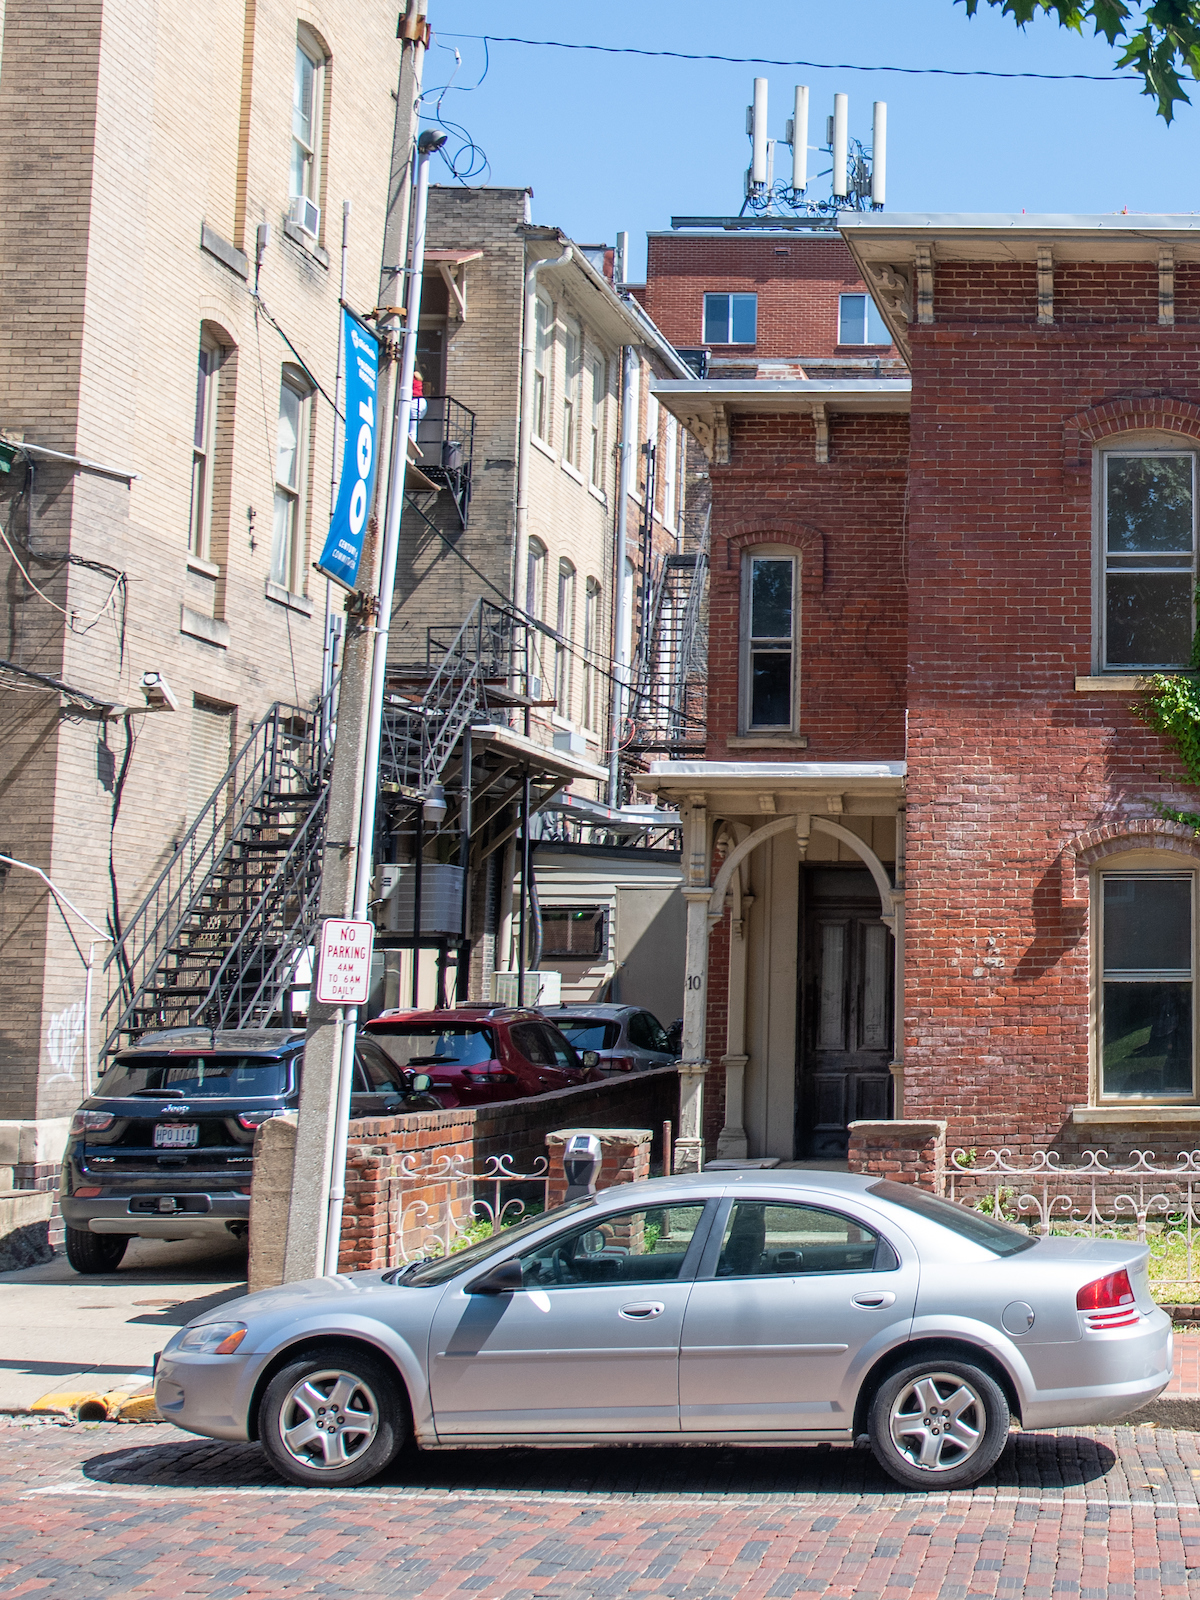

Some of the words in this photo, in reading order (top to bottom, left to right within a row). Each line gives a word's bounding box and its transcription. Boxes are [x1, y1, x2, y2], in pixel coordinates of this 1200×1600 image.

[340, 928, 356, 941] NO
[327, 945, 366, 959] PARKING
[337, 963, 354, 972] 4AM
[329, 973, 338, 983] TO
[343, 975, 361, 984] 6AM
[687, 975, 701, 991] 10
[332, 985, 355, 995] DAILY
[161, 1104, 191, 1115] Jeep
[175, 1129, 196, 1141] 1141
